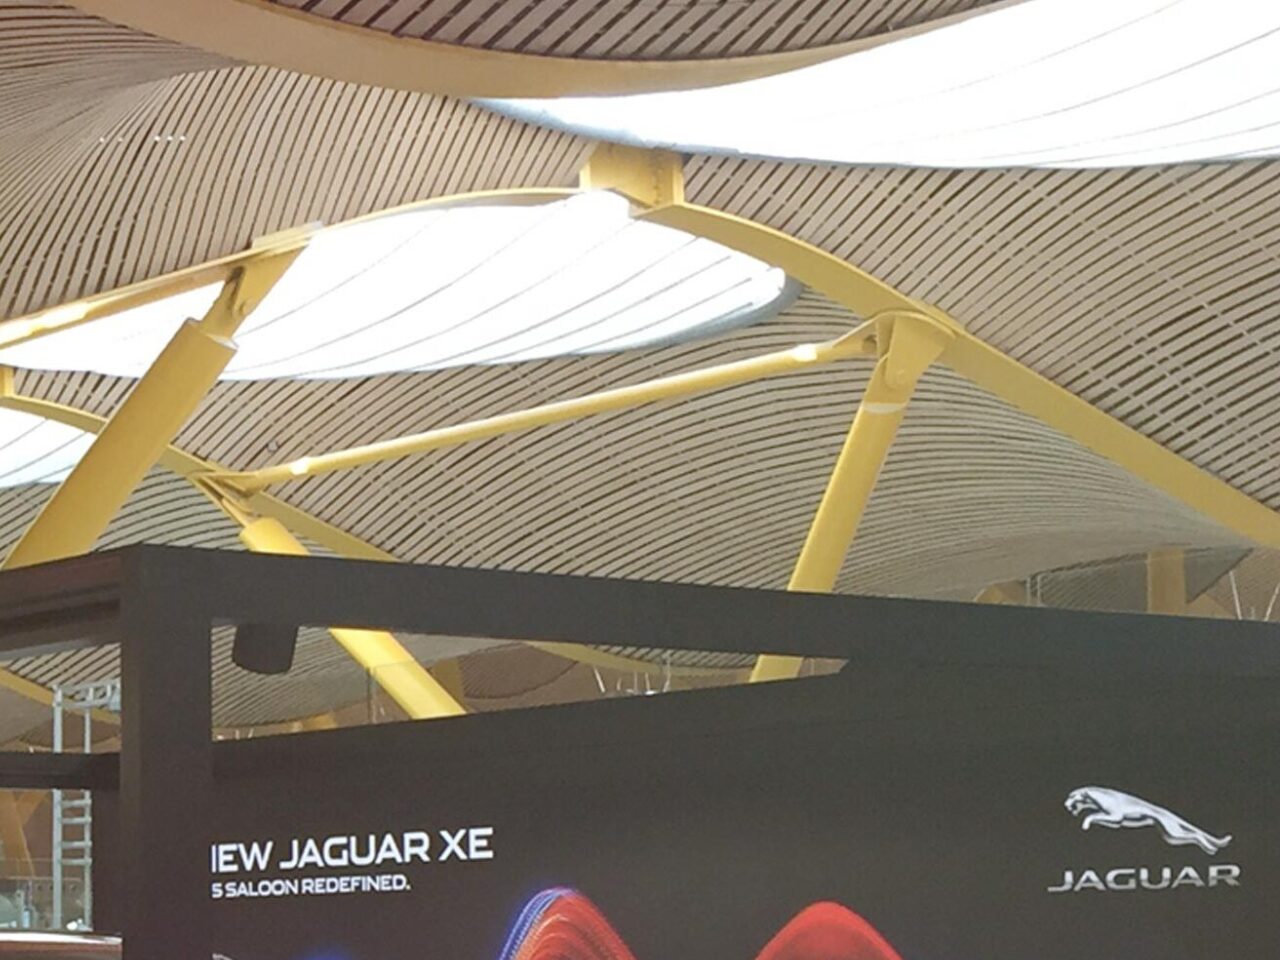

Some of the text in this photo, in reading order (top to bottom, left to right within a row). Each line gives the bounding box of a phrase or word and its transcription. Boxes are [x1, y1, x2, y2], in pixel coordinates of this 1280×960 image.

[279, 831, 431, 869] JAGUAR
[439, 827, 494, 861] XE
[225, 879, 298, 898] SALOON
[301, 873, 411, 894] REDEFINED.
[1047, 864, 1241, 892] JAGUAR
